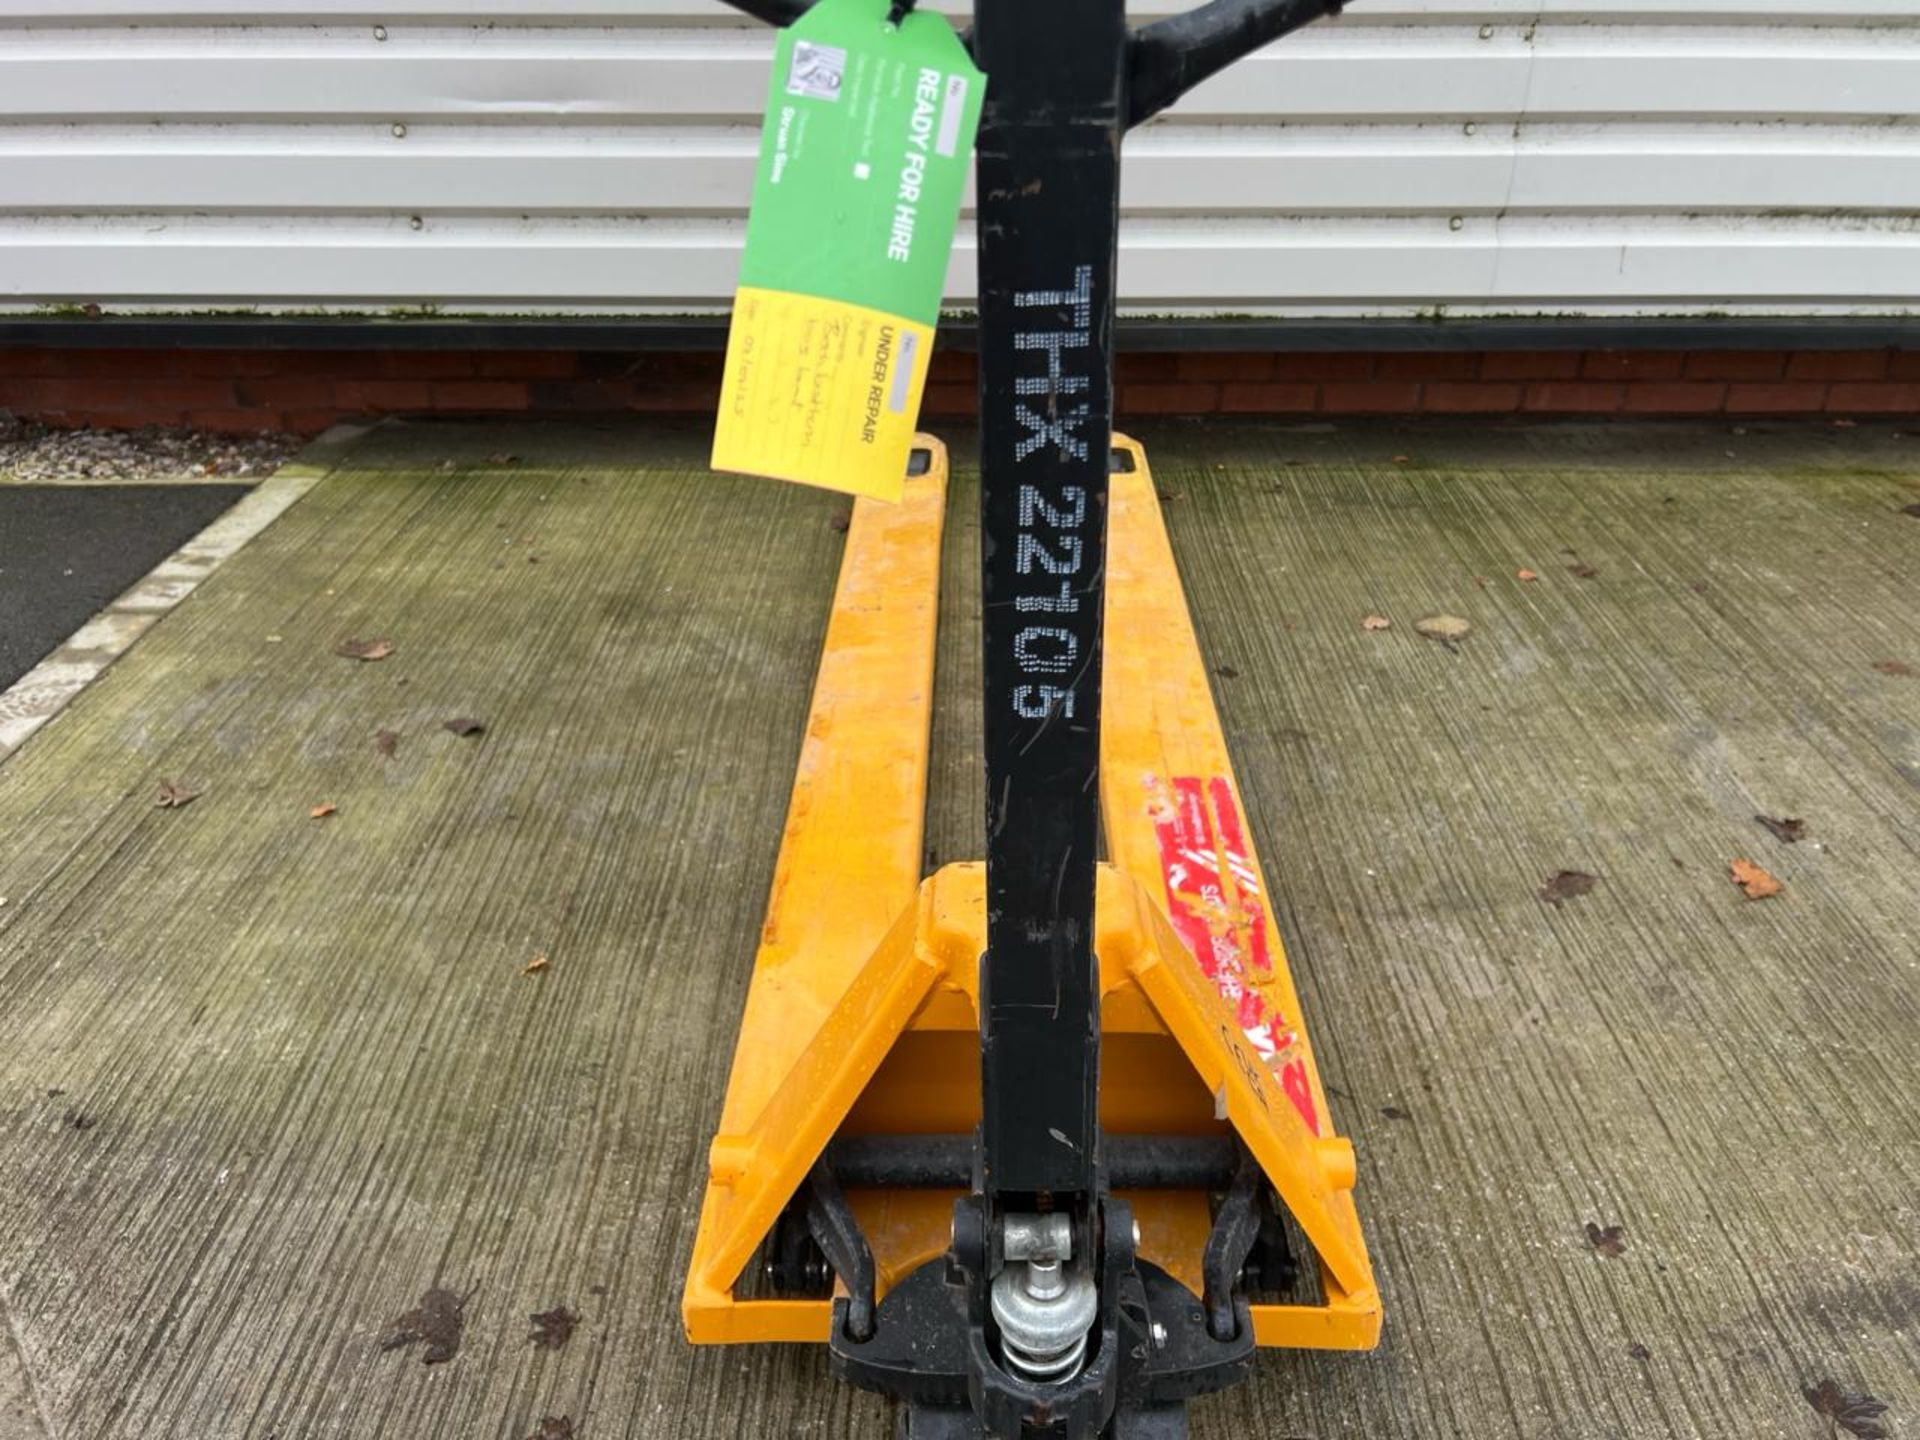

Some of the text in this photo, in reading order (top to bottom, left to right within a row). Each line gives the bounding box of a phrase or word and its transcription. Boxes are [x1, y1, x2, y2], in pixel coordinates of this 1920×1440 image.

[887, 67, 942, 263] READY FOR HIRE
[861, 325, 895, 445] UNDER REPAIR
[1012, 264, 1092, 719] THX 22105
